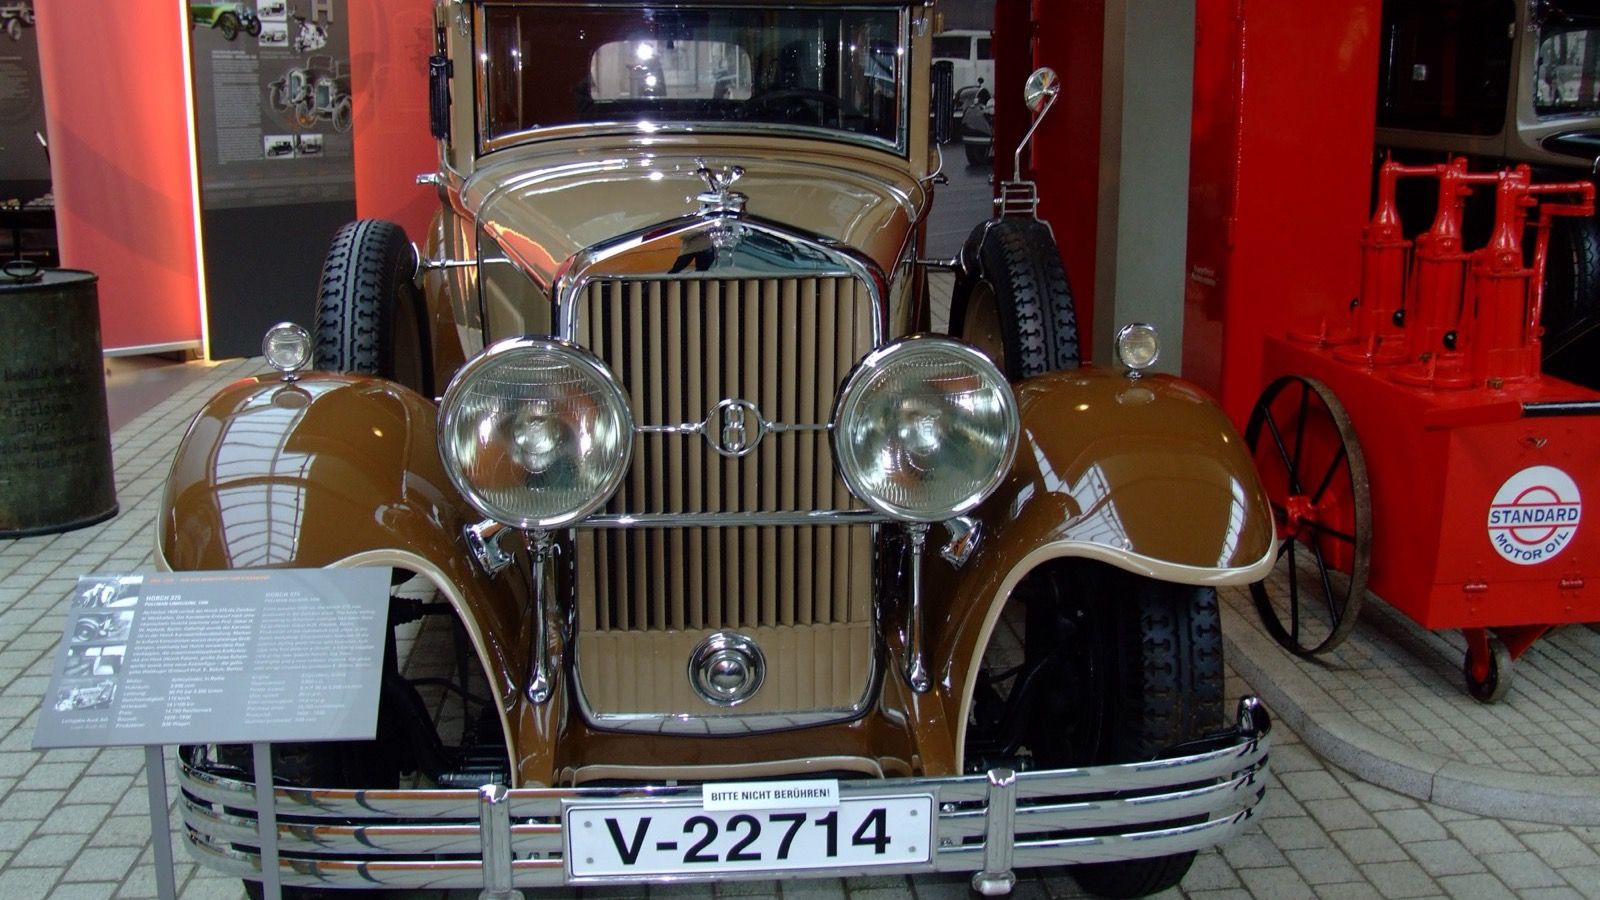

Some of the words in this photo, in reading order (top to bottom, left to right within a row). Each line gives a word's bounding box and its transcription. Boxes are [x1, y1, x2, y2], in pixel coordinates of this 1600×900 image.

[1490, 508, 1578, 524] STANDARD
[1496, 533, 1542, 560] MOTOR
[1545, 531, 1569, 553] OIL
[711, 791, 739, 801] BITTE
[741, 790, 771, 800] NICHT
[774, 788, 830, 799] BERÜHREN!
[604, 808, 892, 865] V-22714
